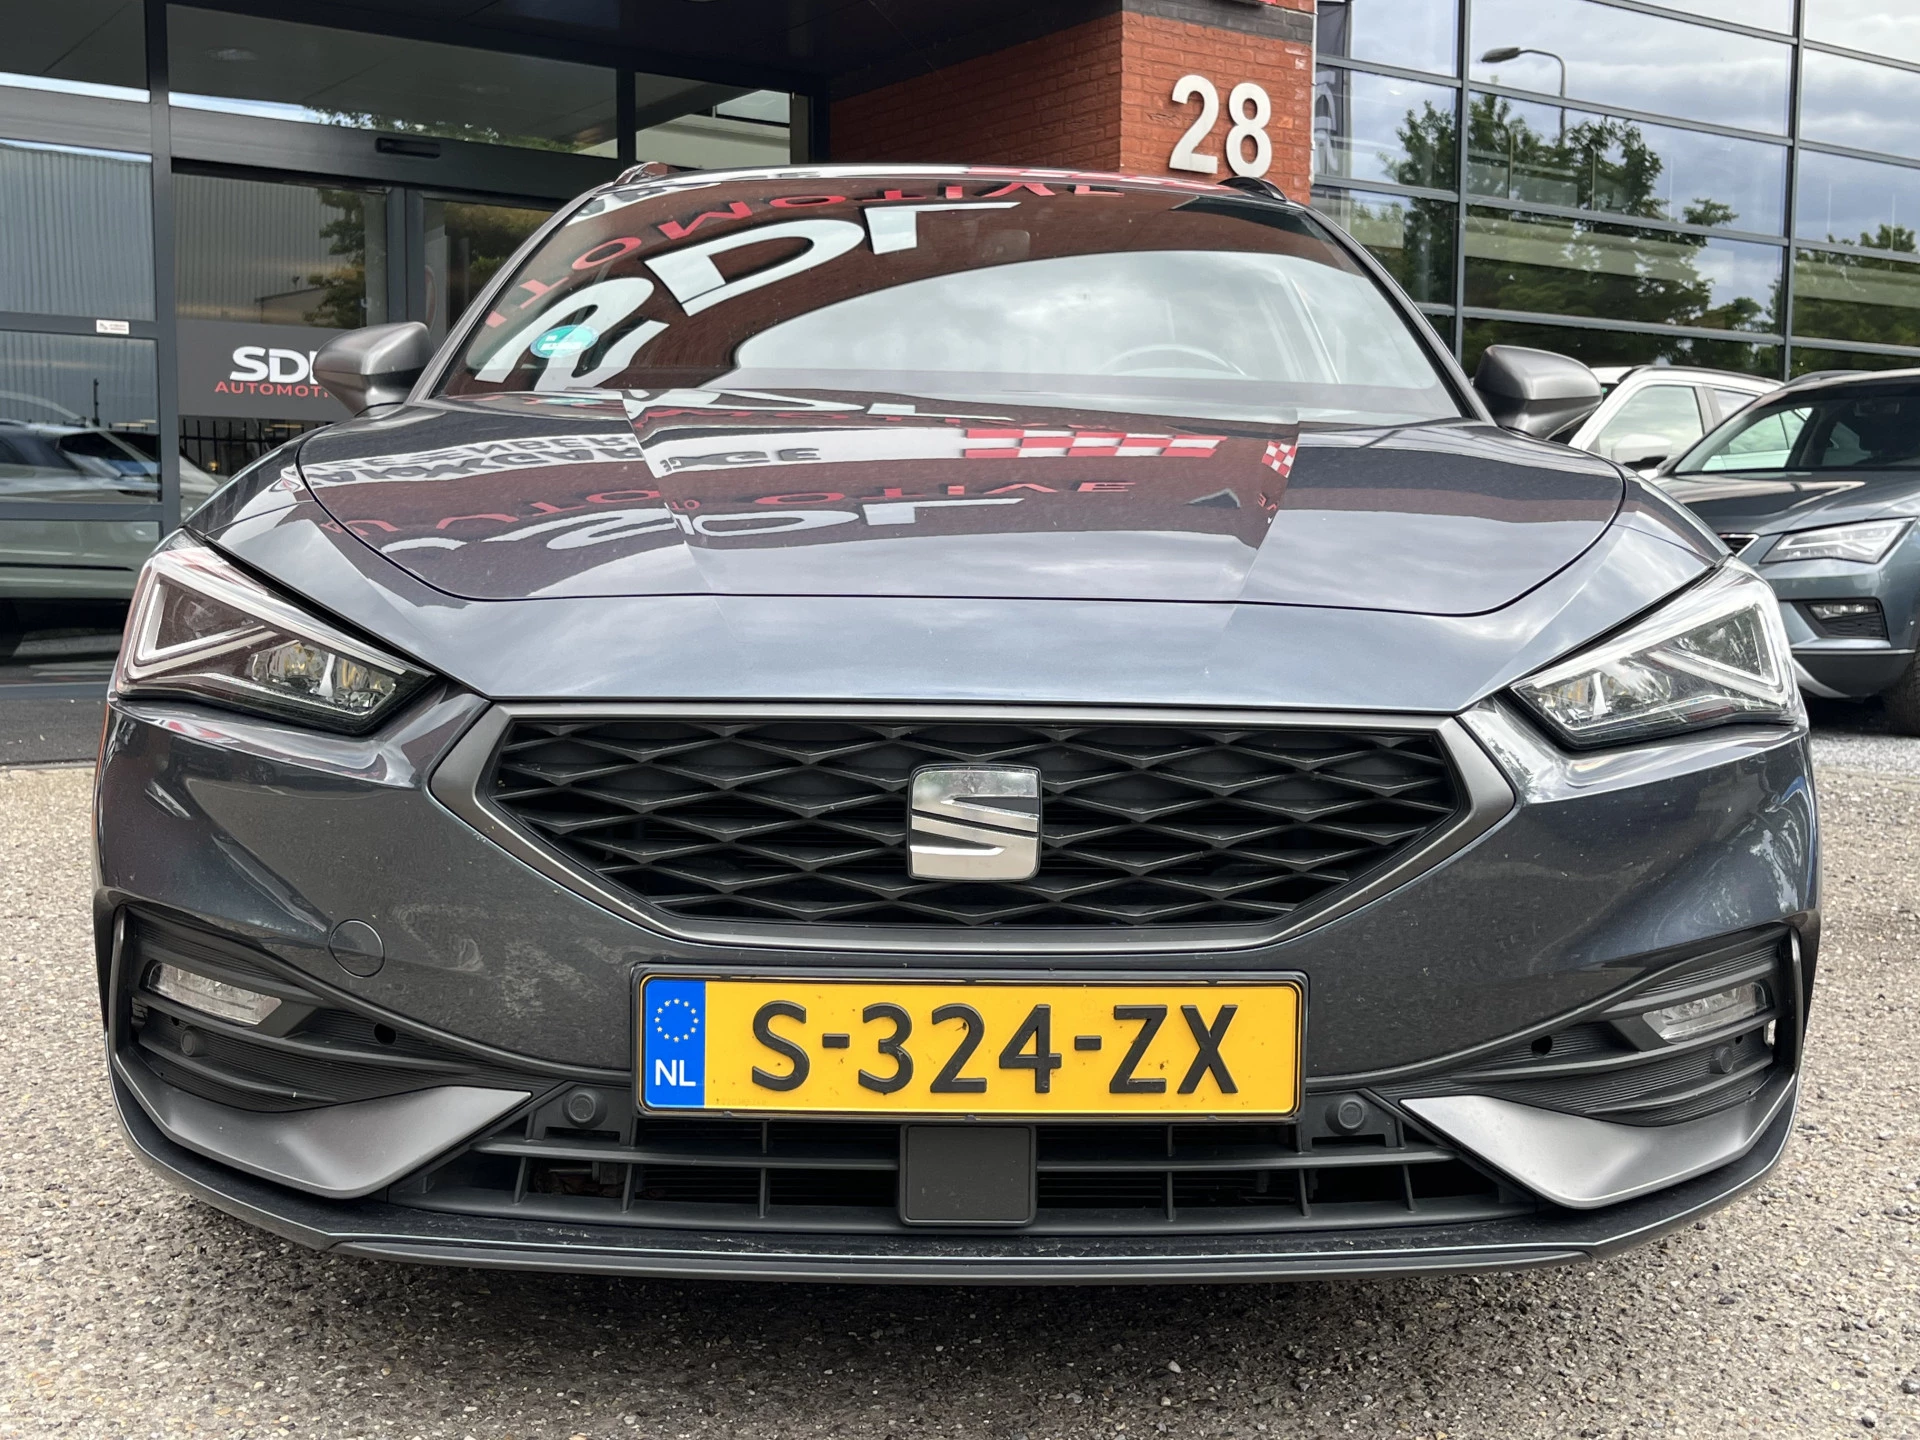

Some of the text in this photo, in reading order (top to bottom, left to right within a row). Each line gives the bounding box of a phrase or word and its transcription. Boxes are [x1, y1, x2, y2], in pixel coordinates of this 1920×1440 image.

[1169, 74, 1272, 178] 28
[654, 1058, 697, 1088] NL
[751, 999, 1239, 1095] S-324-ZX
